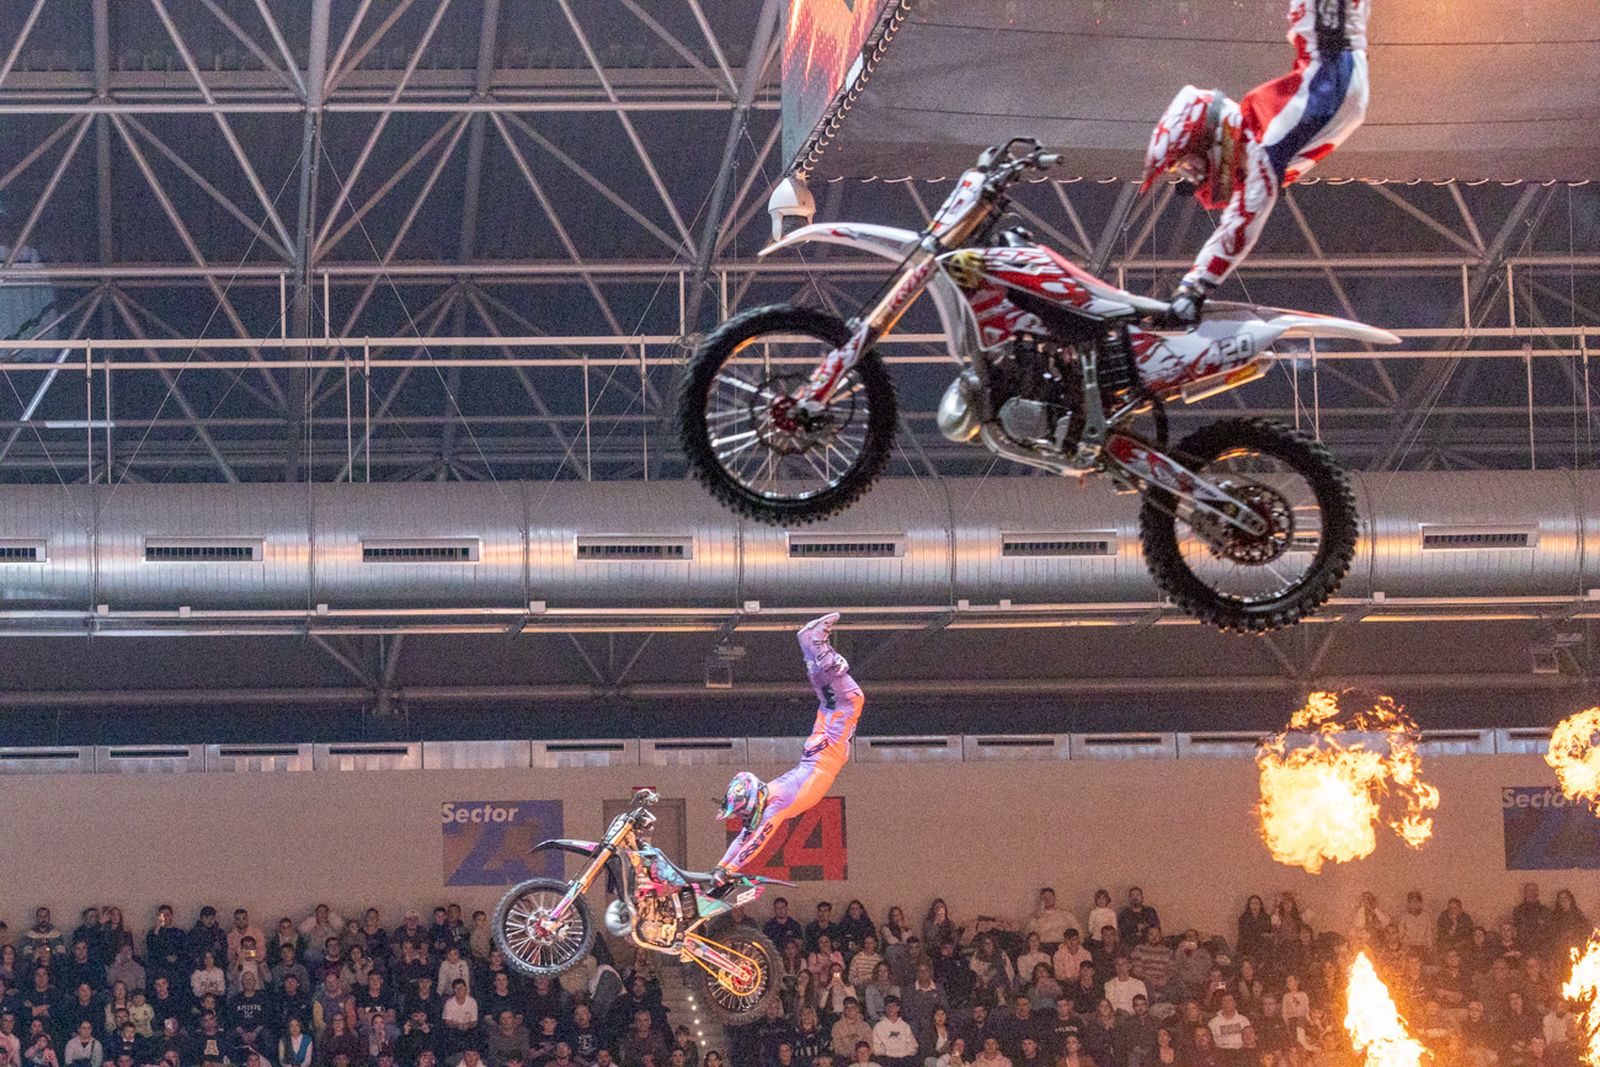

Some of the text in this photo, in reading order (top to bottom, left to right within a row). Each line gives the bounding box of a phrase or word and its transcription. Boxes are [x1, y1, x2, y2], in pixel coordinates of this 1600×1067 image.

[1503, 788, 1573, 808] Secto
[442, 803, 519, 824] Sector
[726, 796, 848, 881] 24
